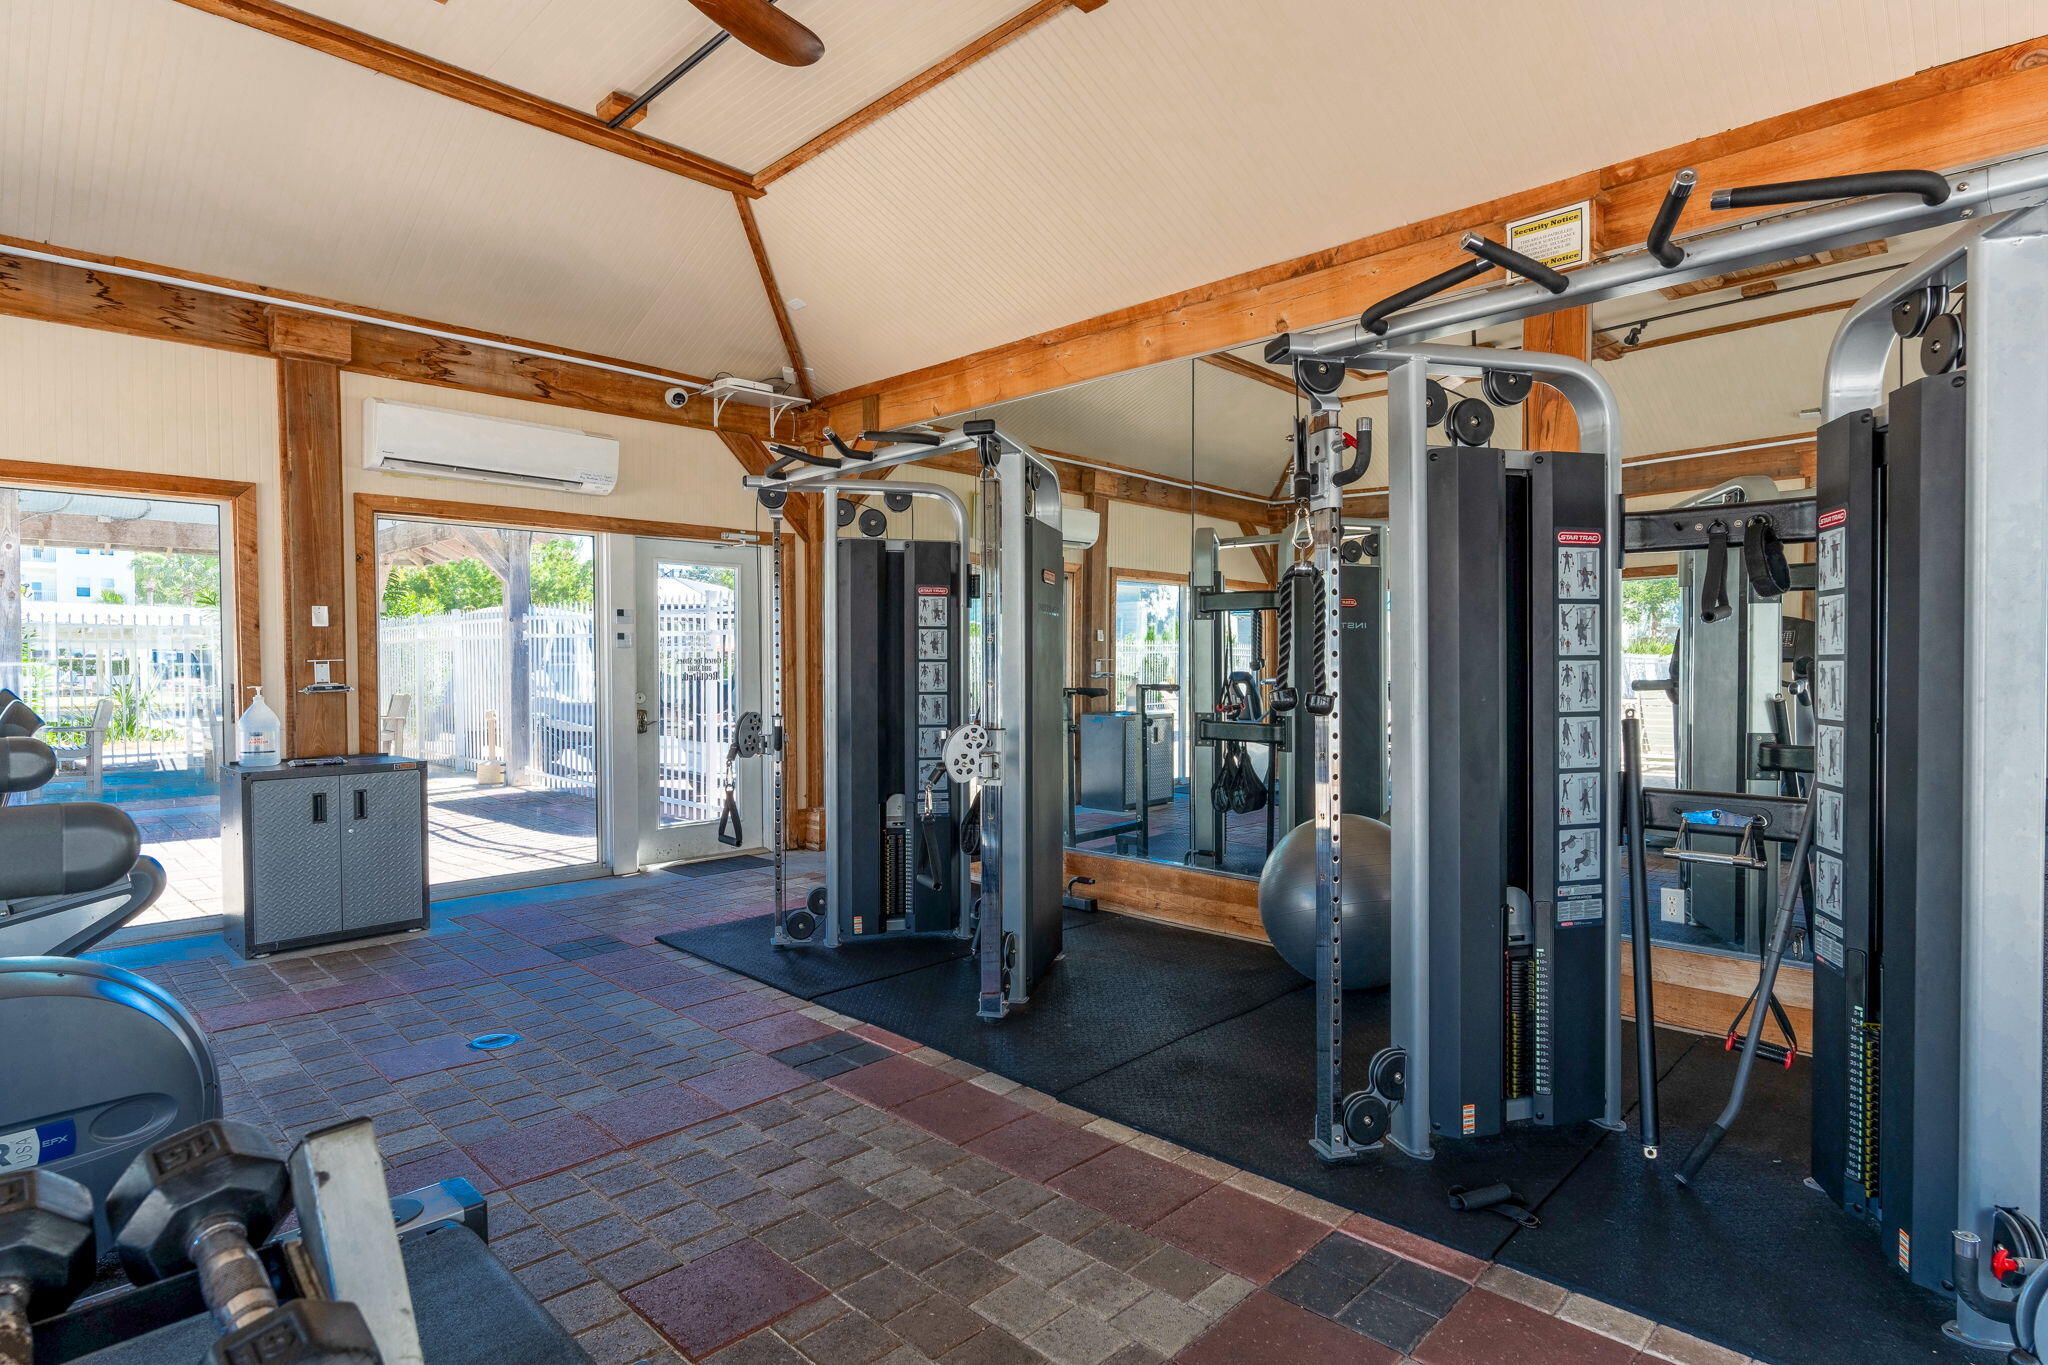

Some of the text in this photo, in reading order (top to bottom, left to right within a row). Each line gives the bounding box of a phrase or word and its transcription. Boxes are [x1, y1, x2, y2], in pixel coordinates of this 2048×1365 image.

[1514, 214, 1579, 236] Security Notice
[1550, 253, 1579, 264] Notice
[1820, 512, 1844, 524] STAR TRAC
[42, 1134, 68, 1148] EFX
[16, 1136, 32, 1163] USA
